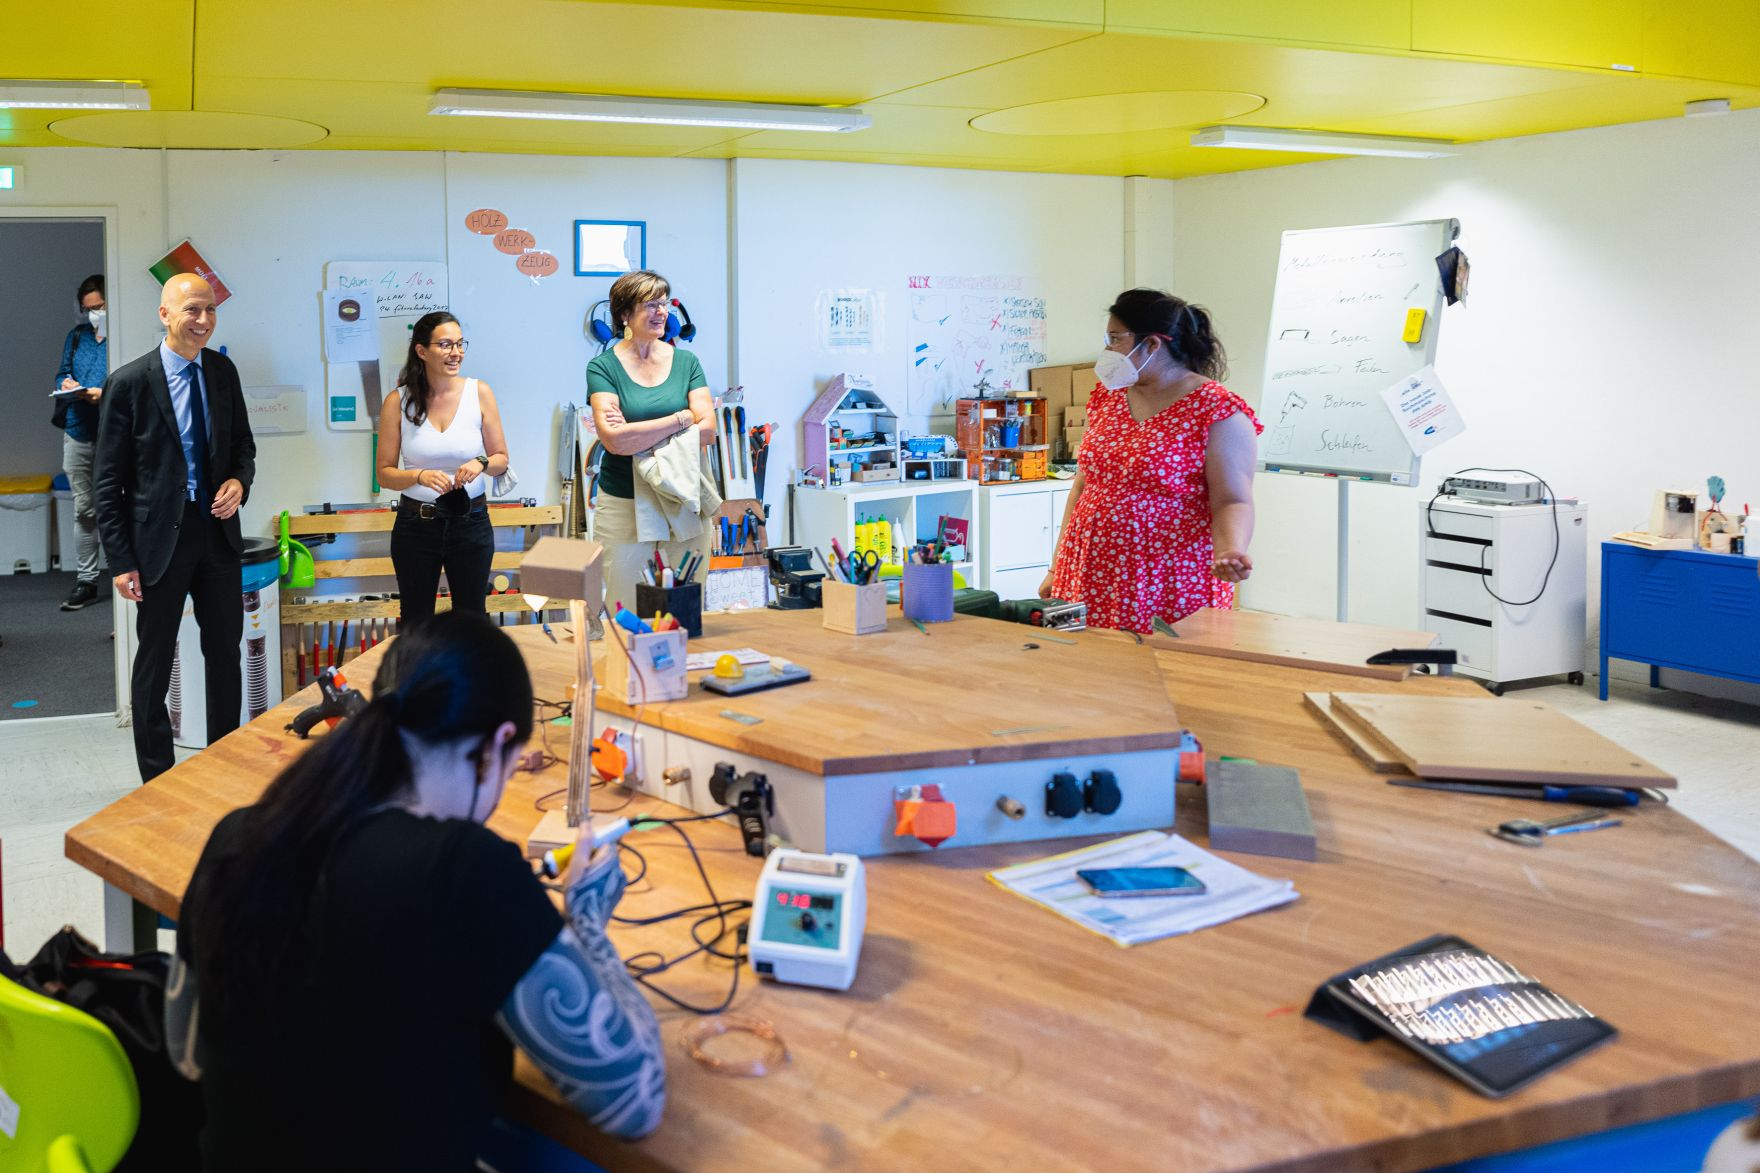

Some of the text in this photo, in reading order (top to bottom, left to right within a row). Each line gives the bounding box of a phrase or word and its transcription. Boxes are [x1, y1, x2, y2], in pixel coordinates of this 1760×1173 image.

[471, 213, 503, 229] HOLZ
[498, 234, 535, 248] WERK-
[521, 256, 551, 268] ZEUG
[1322, 394, 1368, 409] Bohren
[1314, 429, 1374, 455] Schleifen
